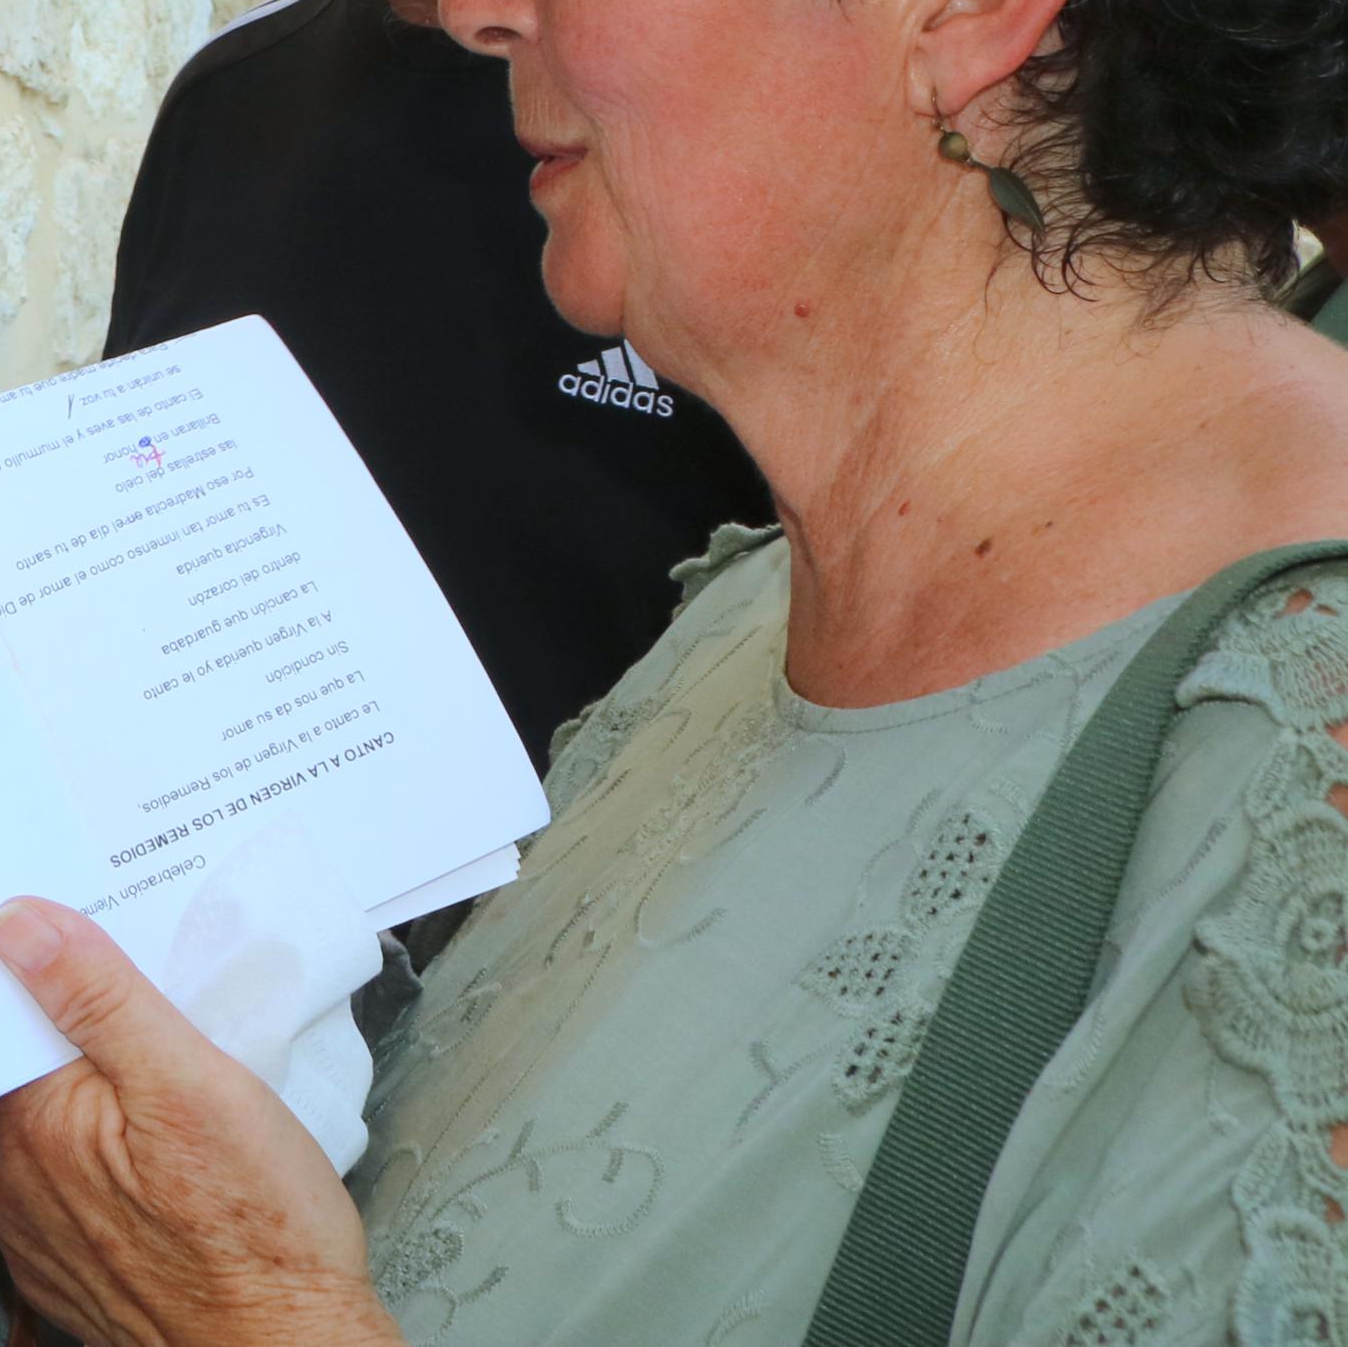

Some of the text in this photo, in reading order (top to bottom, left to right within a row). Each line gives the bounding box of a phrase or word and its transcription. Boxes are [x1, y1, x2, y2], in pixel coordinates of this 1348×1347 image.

[57, 363, 97, 385] madre
[19, 384, 33, 398] tu
[31, 376, 58, 393] que
[78, 364, 181, 405] se unirán a tu voz
[188, 387, 203, 400] El
[153, 393, 186, 410] canto
[558, 372, 674, 417] adidas
[116, 412, 137, 424] las
[136, 405, 152, 416] de
[75, 428, 85, 440] y
[86, 418, 115, 435] aves
[170, 413, 220, 436] Brillaran
[61, 435, 74, 447] el
[152, 431, 169, 443] en
[4, 440, 60, 467] murmullo
[103, 444, 138, 463] honor
[114, 438, 237, 492] las estrellas del cielo
[232, 466, 254, 481] Por
[206, 475, 228, 490] eso
[145, 485, 206, 515] Madrecita
[236, 501, 251, 512] tu
[251, 494, 270, 507] Es
[111, 518, 126, 532] el
[205, 507, 235, 527] amor
[88, 524, 109, 539] día
[181, 521, 203, 536] tan
[53, 542, 69, 554] tu
[69, 534, 87, 547] de
[126, 531, 181, 559] inmenso
[175, 523, 287, 574] Virgencita querida
[15, 548, 52, 570] santo
[89, 554, 124, 575] como
[39, 576, 71, 598] amor
[74, 570, 87, 585] el
[187, 551, 300, 606] dentro del corazón
[18, 592, 35, 606] de
[160, 580, 318, 654] La canción que guardaba
[143, 609, 331, 699] A la Virgen querida yo le canto
[265, 640, 349, 682] Sin condición
[221, 669, 365, 741] La que nos da su amor
[137, 700, 380, 812] Le canto a la Virgen de los Remedios,
[109, 731, 394, 867] CANTO A LA VIRGEN DE LOS REMEDIOS
[119, 854, 205, 899] Celebración
